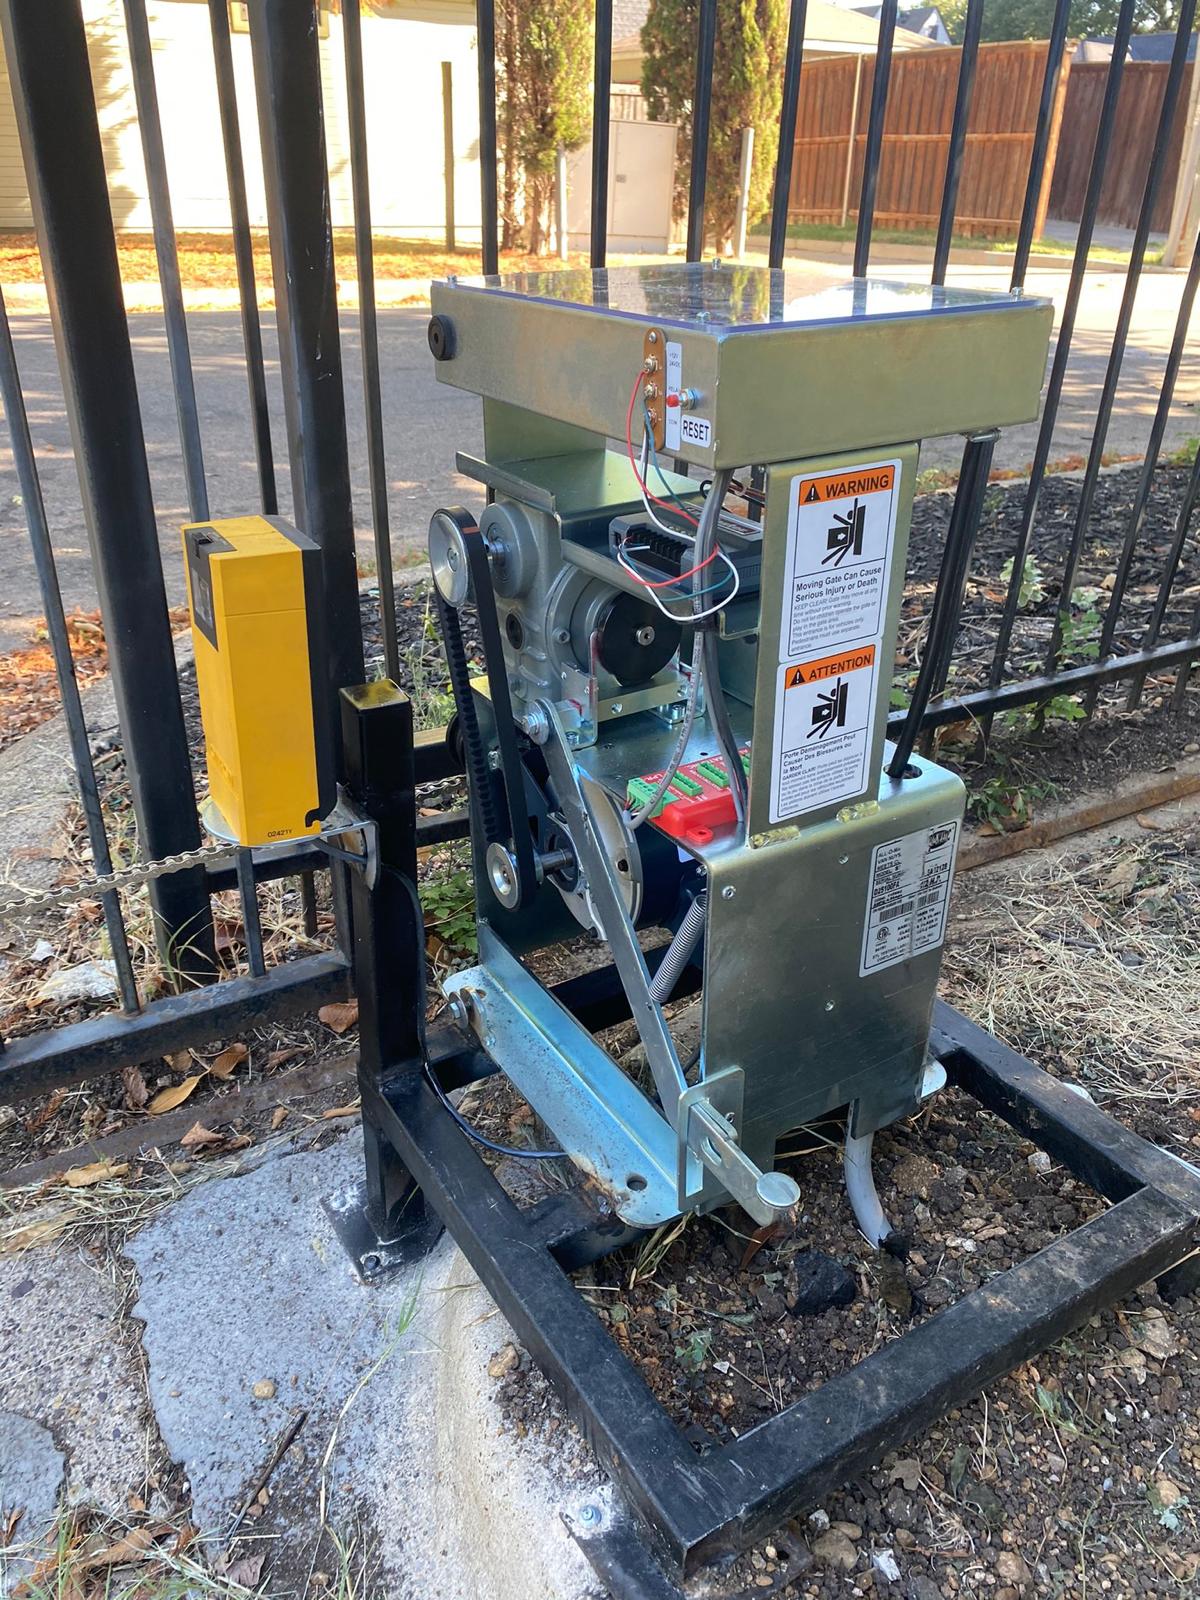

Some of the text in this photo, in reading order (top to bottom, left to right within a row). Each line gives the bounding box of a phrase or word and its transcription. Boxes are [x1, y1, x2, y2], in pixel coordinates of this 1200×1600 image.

[683, 420, 710, 441] RESET
[826, 474, 889, 498] WARNING
[795, 590, 823, 602] Serious
[825, 585, 845, 595] Injury
[857, 578, 877, 588] Death
[796, 566, 881, 591] Moving Gate Can Cause
[808, 654, 872, 680] ATTENTION
[784, 750, 798, 759] Porte
[843, 733, 855, 741] Peut
[783, 756, 802, 766] Causer
[789, 763, 802, 771] Mort
